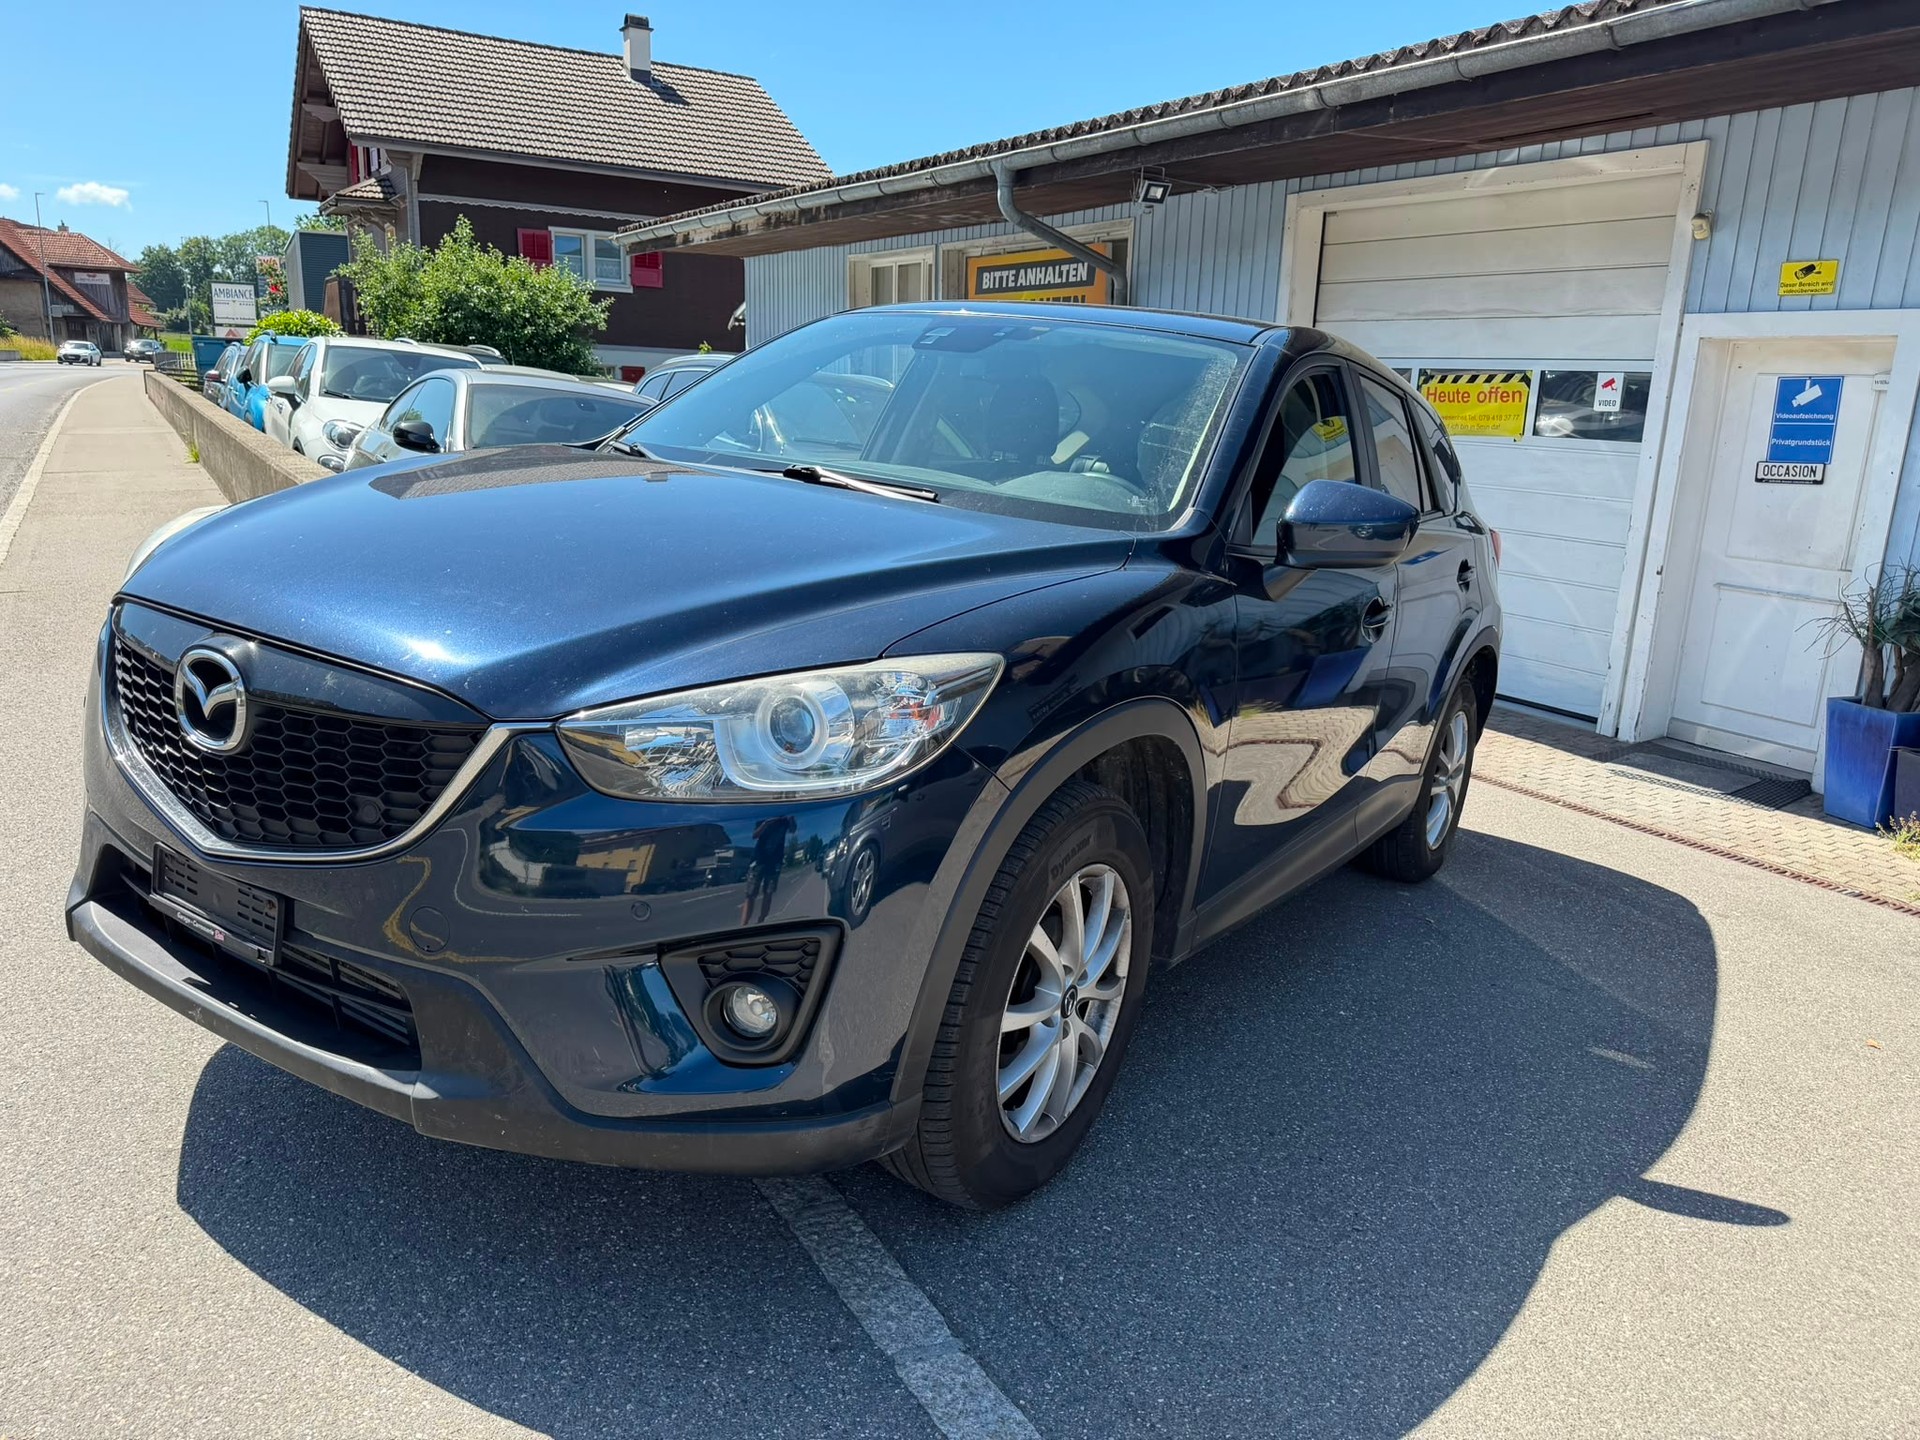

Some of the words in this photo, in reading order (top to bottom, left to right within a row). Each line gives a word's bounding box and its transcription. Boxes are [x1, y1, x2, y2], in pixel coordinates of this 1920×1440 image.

[982, 269, 1016, 289] BITTE
[1017, 262, 1089, 287] ANHALTEN
[213, 287, 254, 300] AMBIANCE
[1426, 386, 1471, 404] Heute
[1476, 386, 1523, 404] offen
[1598, 399, 1617, 407] VIDEO
[1478, 414, 1491, 422] 079
[1771, 438, 1831, 447] Privatgrundstück
[1762, 464, 1818, 478] OCCASION
